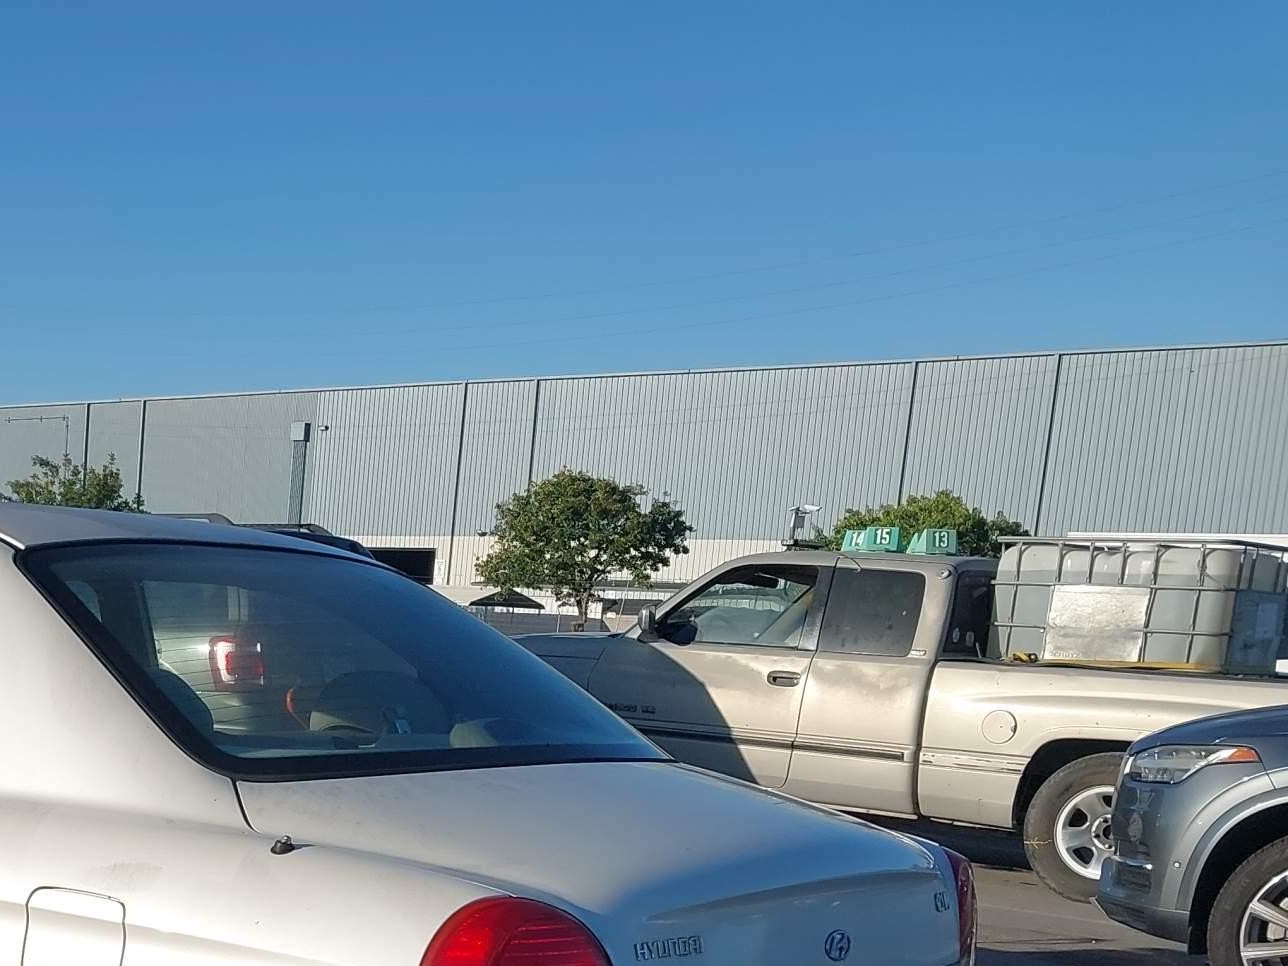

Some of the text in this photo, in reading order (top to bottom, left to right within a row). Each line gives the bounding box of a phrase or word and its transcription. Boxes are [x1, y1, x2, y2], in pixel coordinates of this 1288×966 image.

[851, 531, 865, 547] 14
[875, 528, 891, 545] 15
[934, 531, 949, 548] 13
